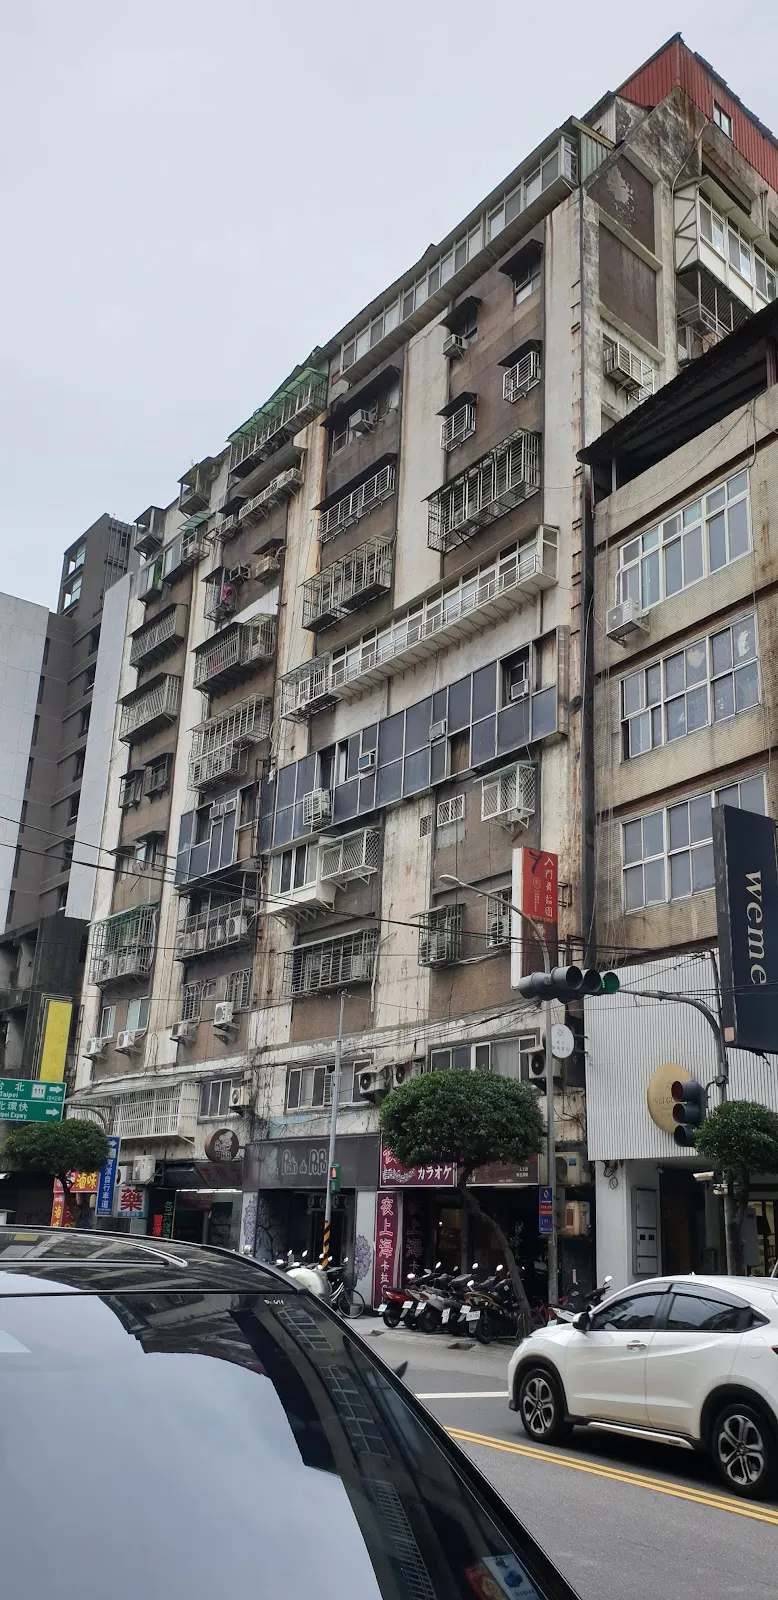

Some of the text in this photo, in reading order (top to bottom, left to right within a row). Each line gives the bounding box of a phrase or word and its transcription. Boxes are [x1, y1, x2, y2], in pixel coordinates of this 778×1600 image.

[744, 870, 767, 985] weme
[34, 1087, 44, 1095] 111
[76, 1172, 98, 1190] 滷味
[417, 1165, 452, 1181] カラオケ
[120, 1187, 144, 1212] 藥
